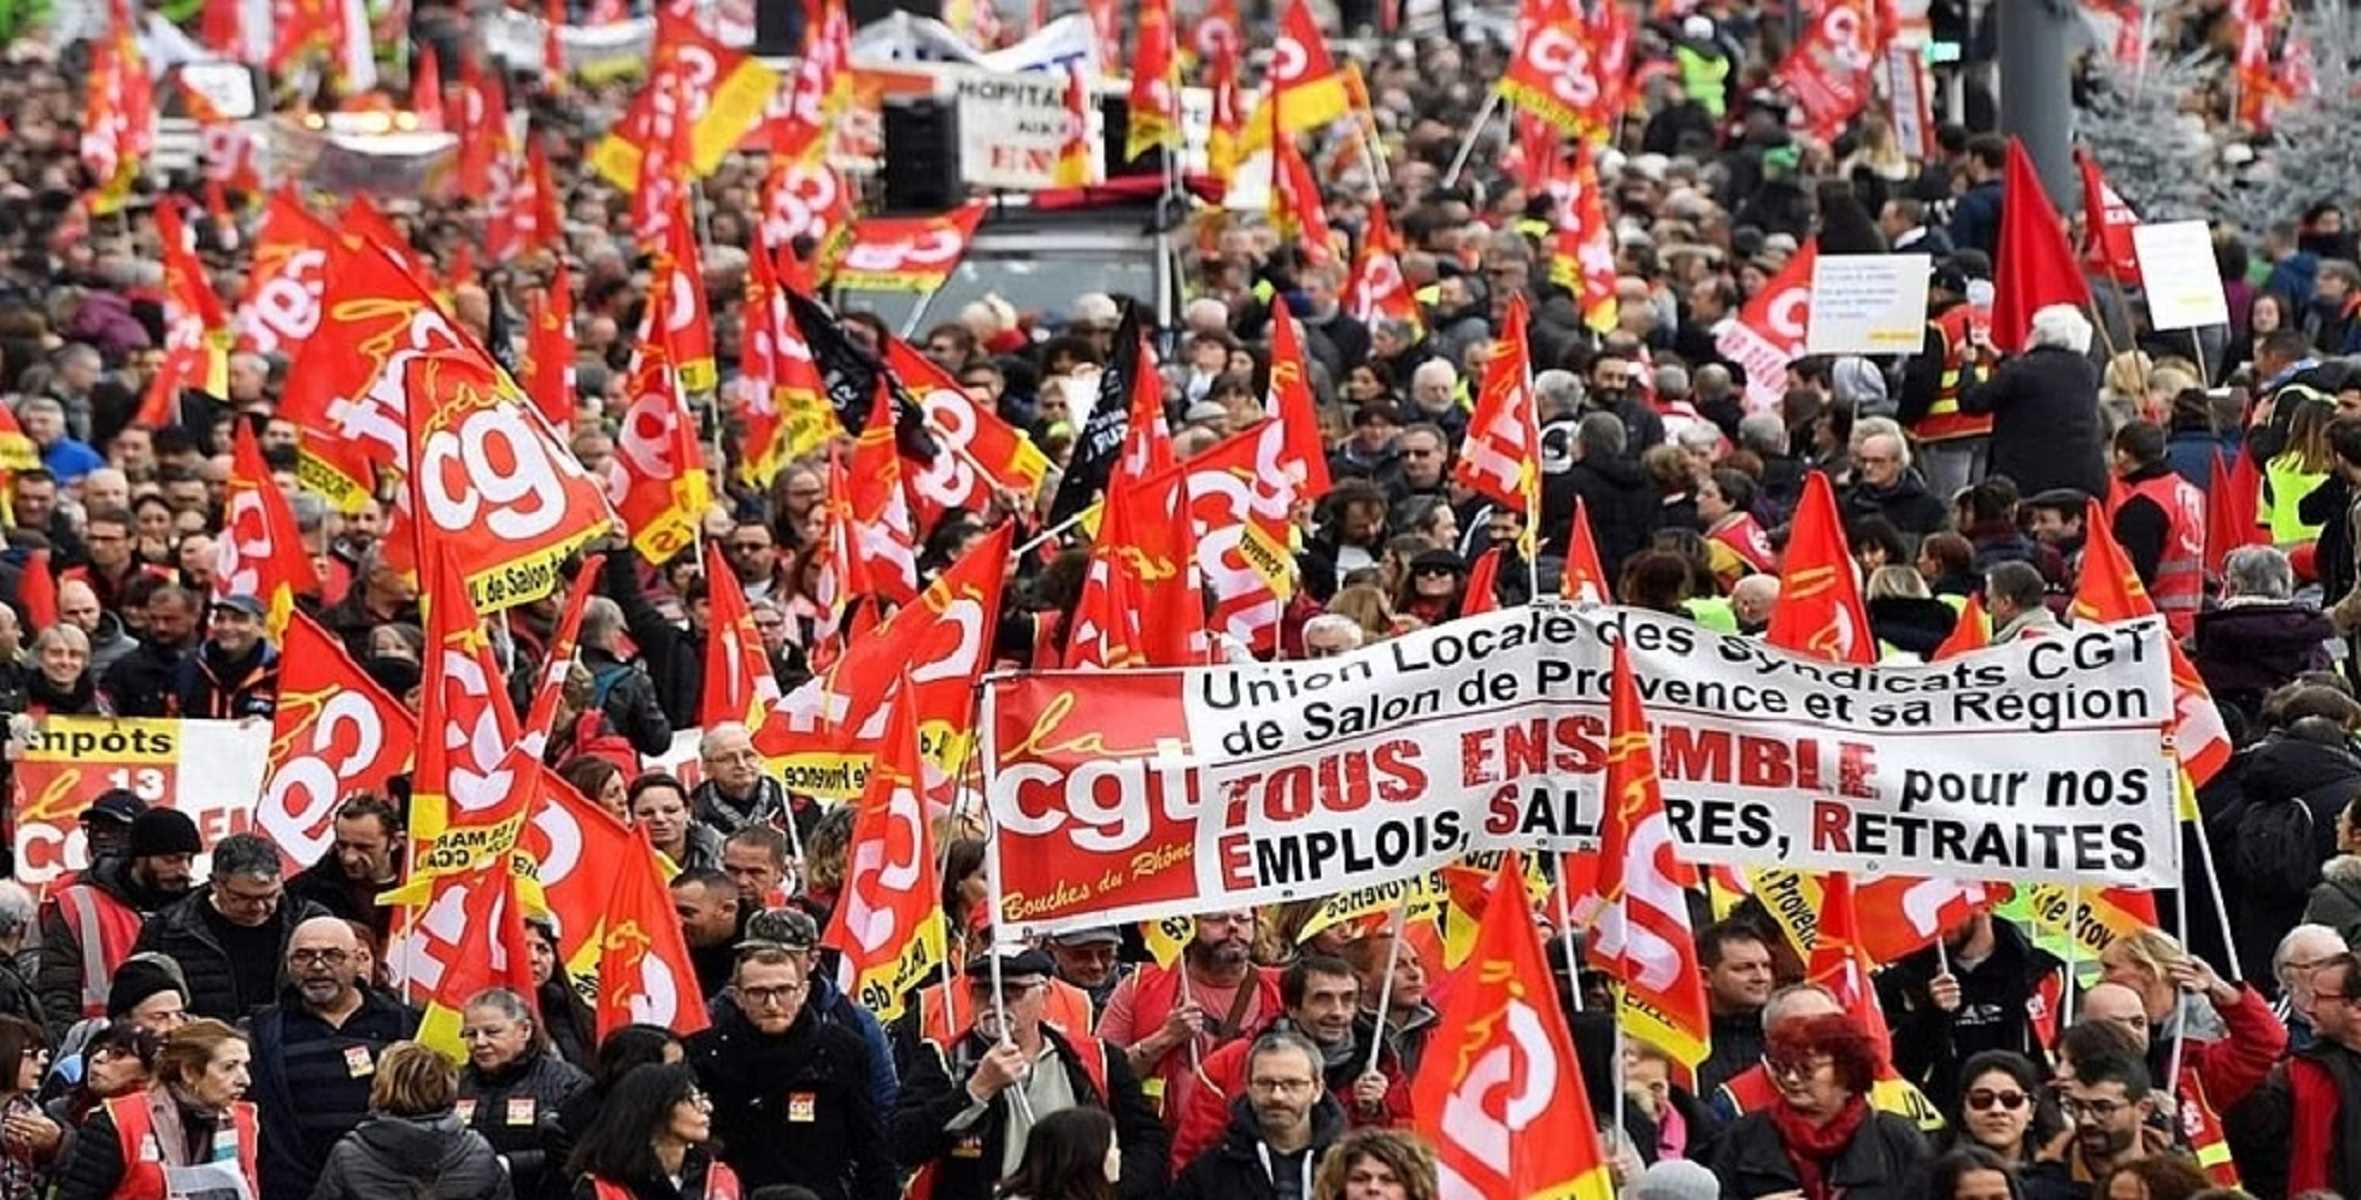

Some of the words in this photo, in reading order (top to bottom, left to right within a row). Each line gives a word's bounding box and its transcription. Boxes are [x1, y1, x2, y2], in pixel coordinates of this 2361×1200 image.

[1203, 661, 1371, 709] Union
[1392, 611, 1576, 673] Locale
[1596, 612, 1694, 657] des
[1718, 634, 2007, 694] Syndicats
[2028, 619, 2156, 681] CGT
[1222, 720, 1284, 756] de
[1303, 689, 1440, 742] Salon
[1458, 668, 1518, 707] de
[1804, 691, 1853, 723] et
[1870, 700, 1932, 727] sa
[1954, 684, 2148, 732] Région
[108, 767, 166, 801] 13
[992, 737, 1200, 852] cgt
[1219, 739, 1429, 829] TOUS
[1460, 715, 1881, 799] ENSMBLE
[1900, 768, 2029, 812] pour
[2046, 768, 2148, 807] nos
[1002, 881, 1091, 921] Bouches
[1099, 869, 1124, 893] du
[1131, 842, 1193, 881] Rhône
[1219, 810, 1469, 892] EMPLOIS,
[1485, 784, 1790, 860] SALRES,
[1813, 800, 2146, 871] RETRAITES
